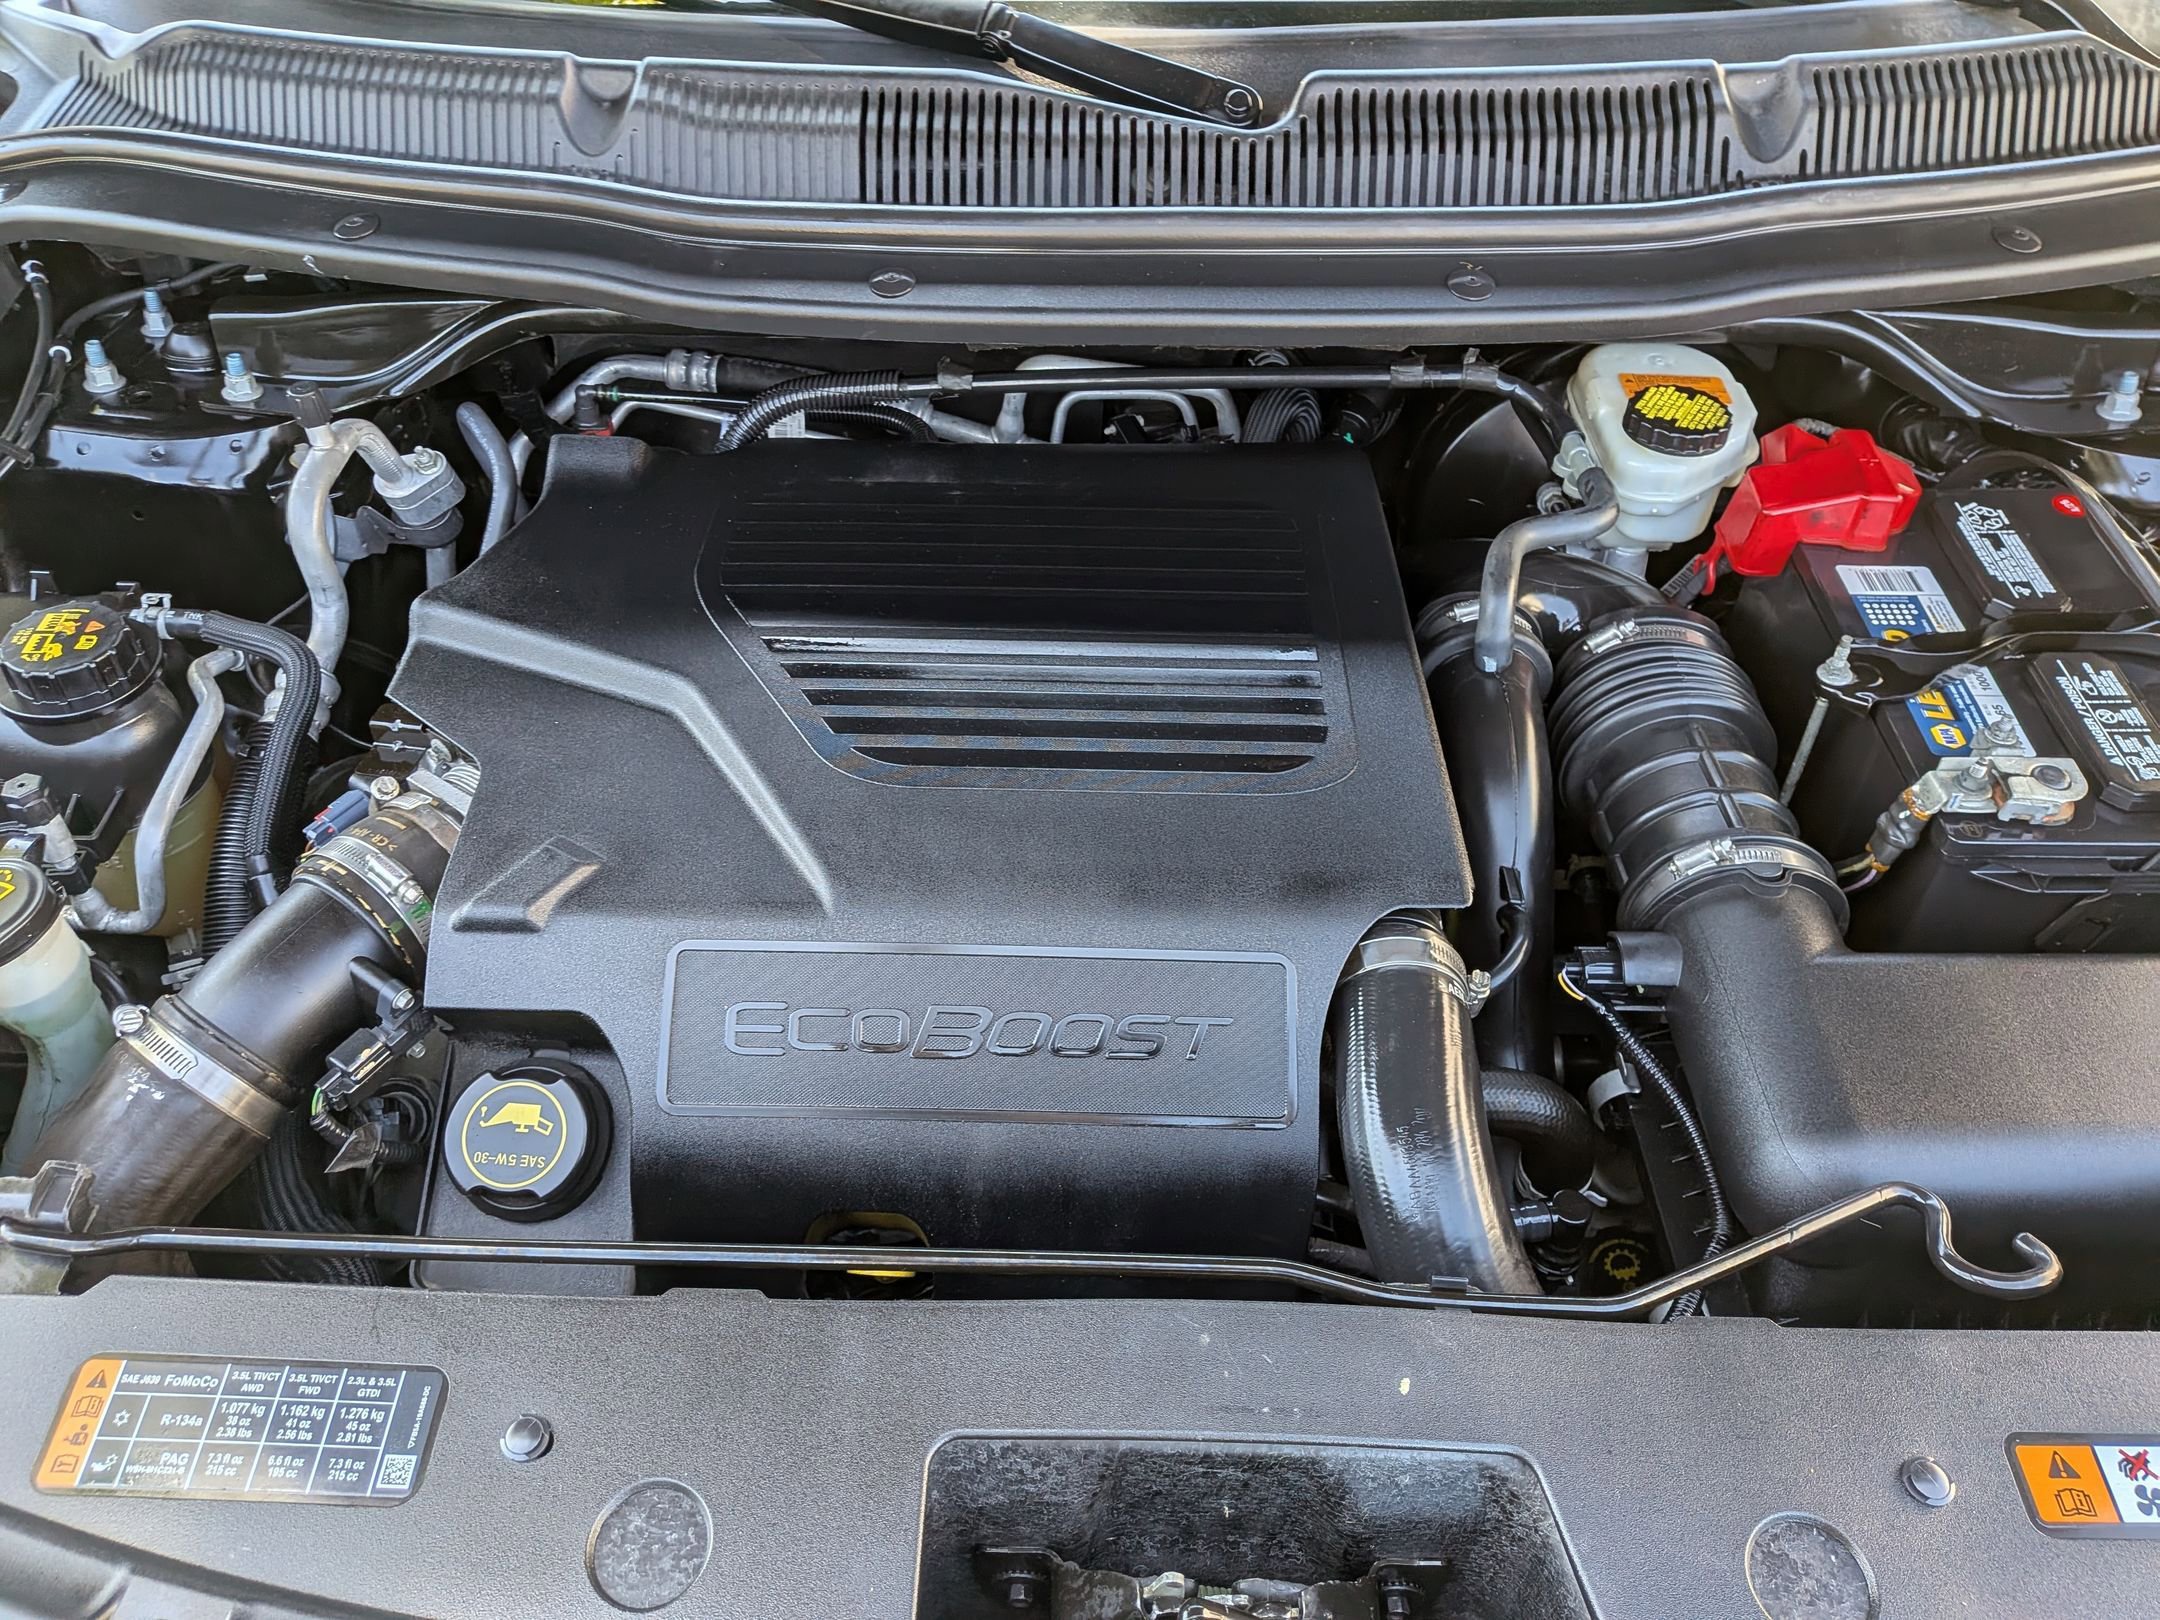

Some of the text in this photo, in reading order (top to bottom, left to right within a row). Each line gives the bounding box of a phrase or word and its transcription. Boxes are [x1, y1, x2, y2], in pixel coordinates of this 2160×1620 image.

[2055, 676, 2087, 710] POISON
[1938, 728, 1958, 745] NAPA
[2083, 718, 2117, 756] DANGER
[473, 1151, 546, 1168] SAE 5W-30
[121, 1374, 140, 1384] SAE
[164, 1374, 219, 1388] FoMoCo
[231, 1371, 251, 1380] 3.5L
[288, 1374, 308, 1383] 3.5L
[240, 1383, 264, 1392] AWD
[347, 1377, 397, 1387] 2.3L & 3.5L
[298, 1386, 321, 1395] FWD
[357, 1388, 381, 1397] GTDI
[221, 1402, 266, 1418] 1.077 kg
[281, 1404, 326, 1420] 1.162 kg
[340, 1407, 385, 1422] 1.276 kg
[160, 1414, 203, 1427] R-134a
[225, 1416, 252, 1426] 38 oz
[286, 1418, 311, 1428] 41 oz
[345, 1421, 371, 1431] 45 oz
[215, 1427, 252, 1438] 2.38 lbs
[276, 1429, 313, 1440] 2.56 lbs
[336, 1432, 373, 1443] 2.81 lbs
[160, 1452, 190, 1465] PAG
[207, 1453, 244, 1464] 7.3 fl oz
[267, 1455, 305, 1466] 6.6 fl oz
[328, 1458, 366, 1469] 7.3 fl oz
[205, 1465, 237, 1476] 215 cc
[268, 1466, 298, 1478] 195 cc
[327, 1470, 359, 1481] 215 cc
